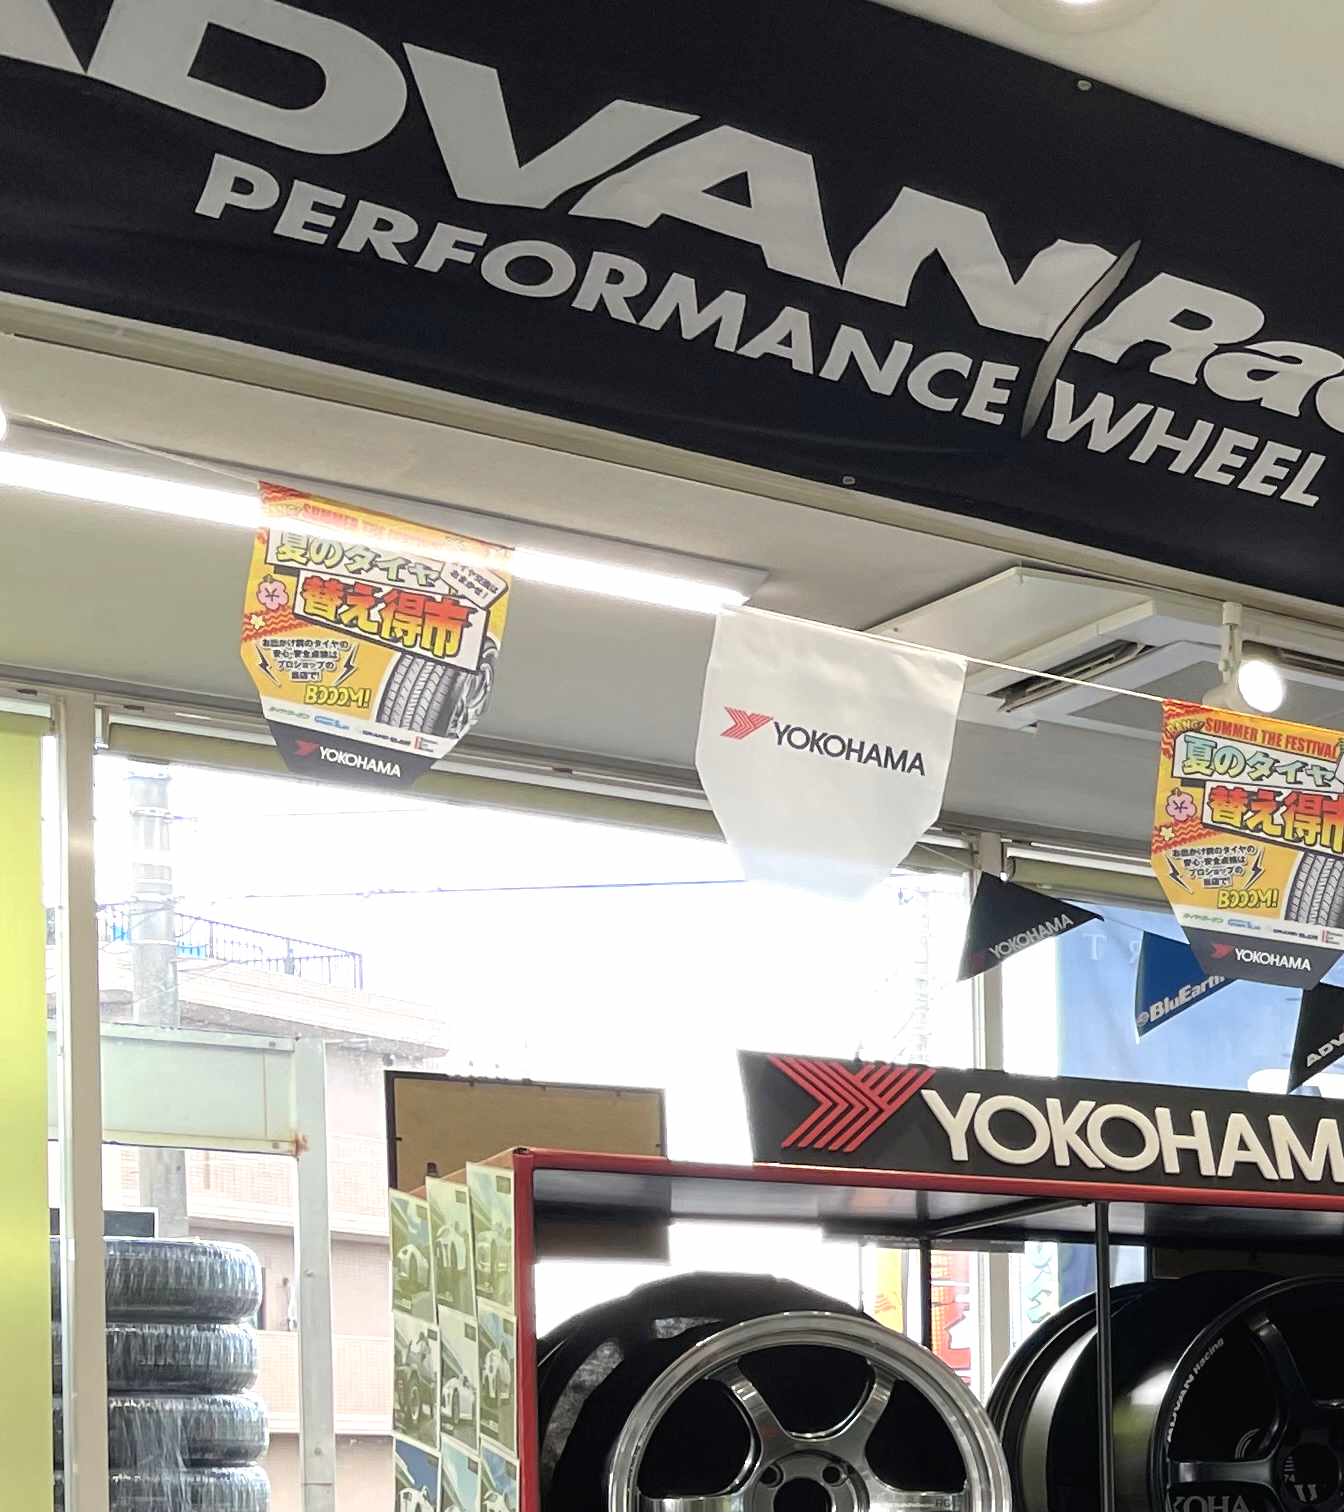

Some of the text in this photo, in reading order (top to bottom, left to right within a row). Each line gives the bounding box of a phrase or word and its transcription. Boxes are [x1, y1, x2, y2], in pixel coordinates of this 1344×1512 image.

[194, 152, 1328, 507] PERFORMANCE WHEEL
[300, 575, 474, 658] 替え得市
[774, 720, 926, 778] YOKOHAMA
[1204, 716, 1259, 741] SUMMER
[1261, 729, 1284, 747] THE
[319, 746, 402, 778] YOKOHAMA
[988, 914, 1074, 961] YOKOHAMA
[1235, 948, 1312, 972] YOKOHAMA
